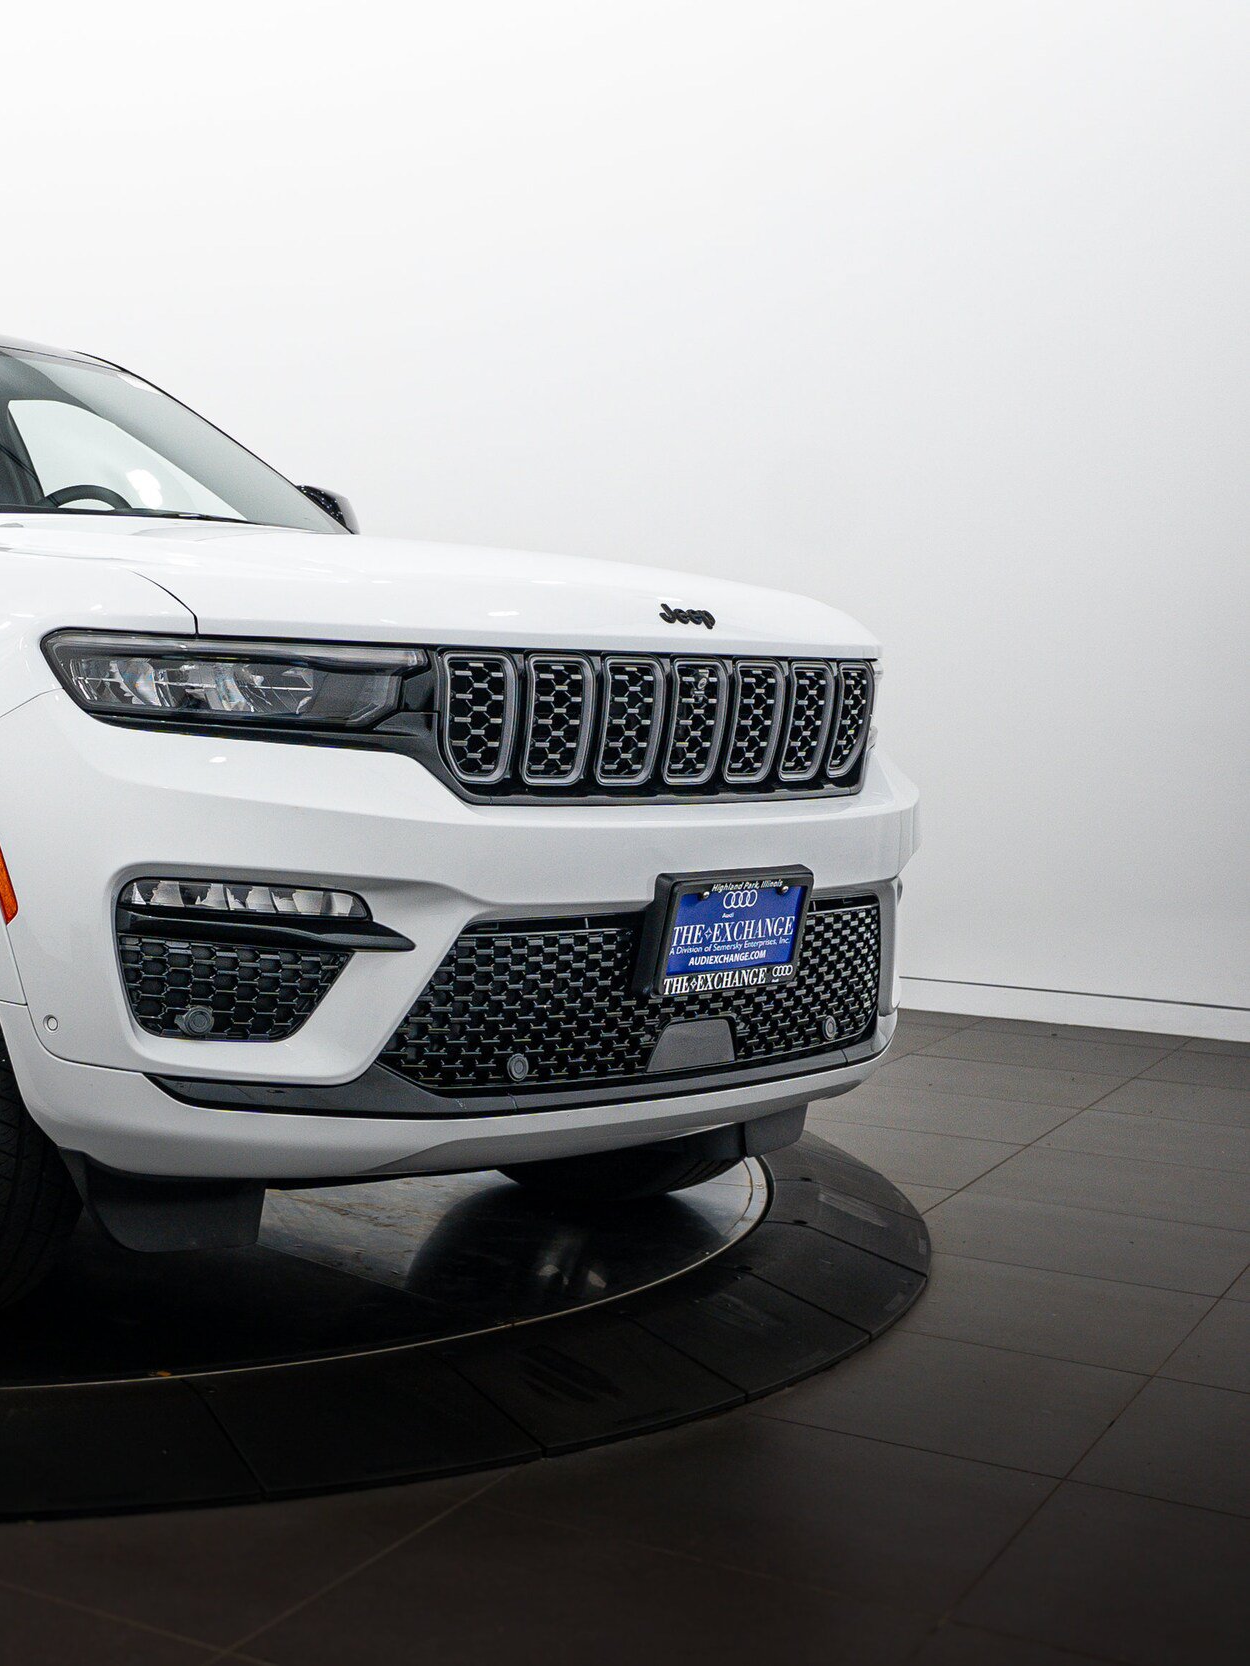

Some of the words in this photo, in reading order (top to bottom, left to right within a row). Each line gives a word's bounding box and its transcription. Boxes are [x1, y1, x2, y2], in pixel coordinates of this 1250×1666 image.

[659, 603, 716, 630] Jeep
[711, 882, 743, 893] Highland
[761, 879, 783, 889] Illinois
[672, 924, 705, 947] THE
[711, 915, 796, 943] EXCHANGE
[676, 945, 703, 955] Division
[704, 943, 712, 952] of
[688, 950, 767, 966] AUDIEXCHANGE.COM
[663, 977, 691, 996] THE
[695, 967, 767, 992] EXCHANGE
